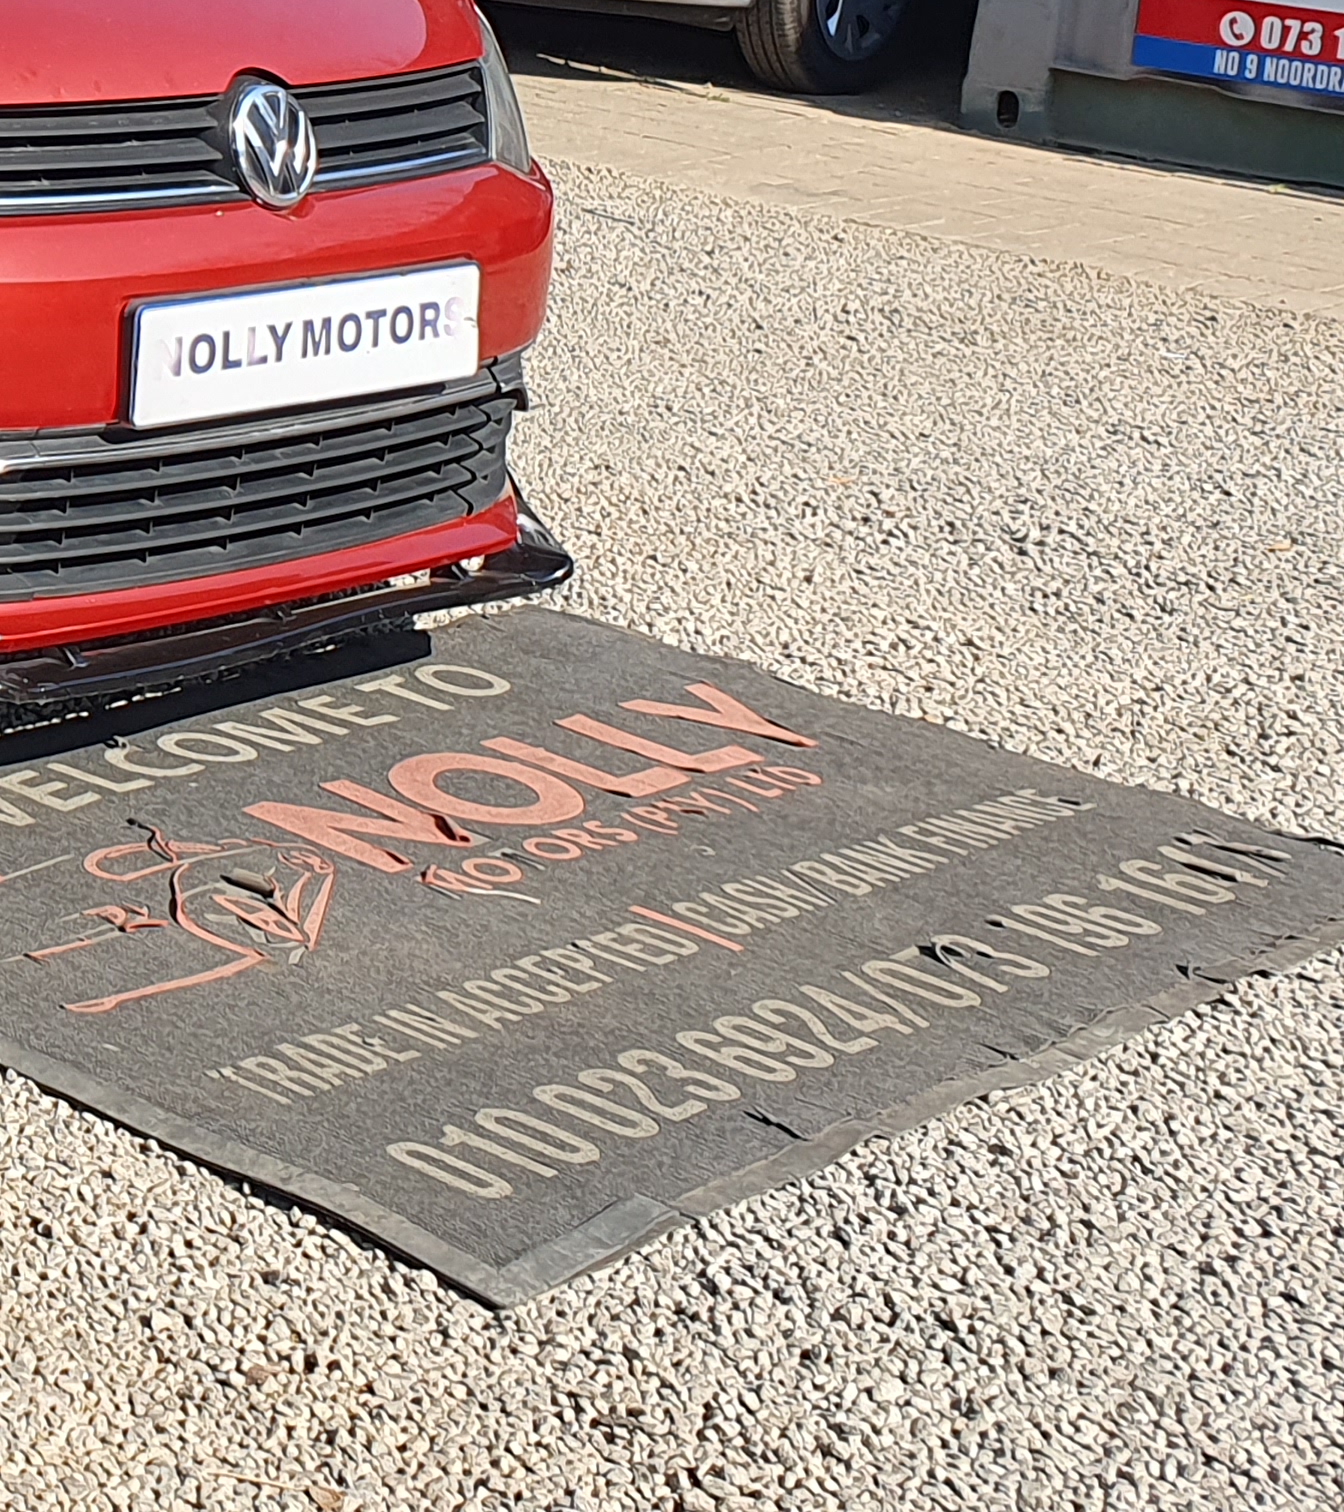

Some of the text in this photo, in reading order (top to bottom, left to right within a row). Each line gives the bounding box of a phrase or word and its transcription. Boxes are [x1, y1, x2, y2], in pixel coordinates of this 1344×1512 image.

[1213, 49, 1240, 76] NO
[1244, 54, 1259, 80] 9
[1260, 16, 1324, 56] 073
[300, 296, 465, 359] MOTORS
[353, 664, 512, 711] TO
[242, 682, 817, 873] NOLLY
[206, 788, 1098, 1104] TRADE IN ACCEPTED CASH/BANK FINANCE
[385, 1107, 601, 1199] 010
[531, 1048, 742, 1138] 023
[984, 892, 1163, 956] 196
